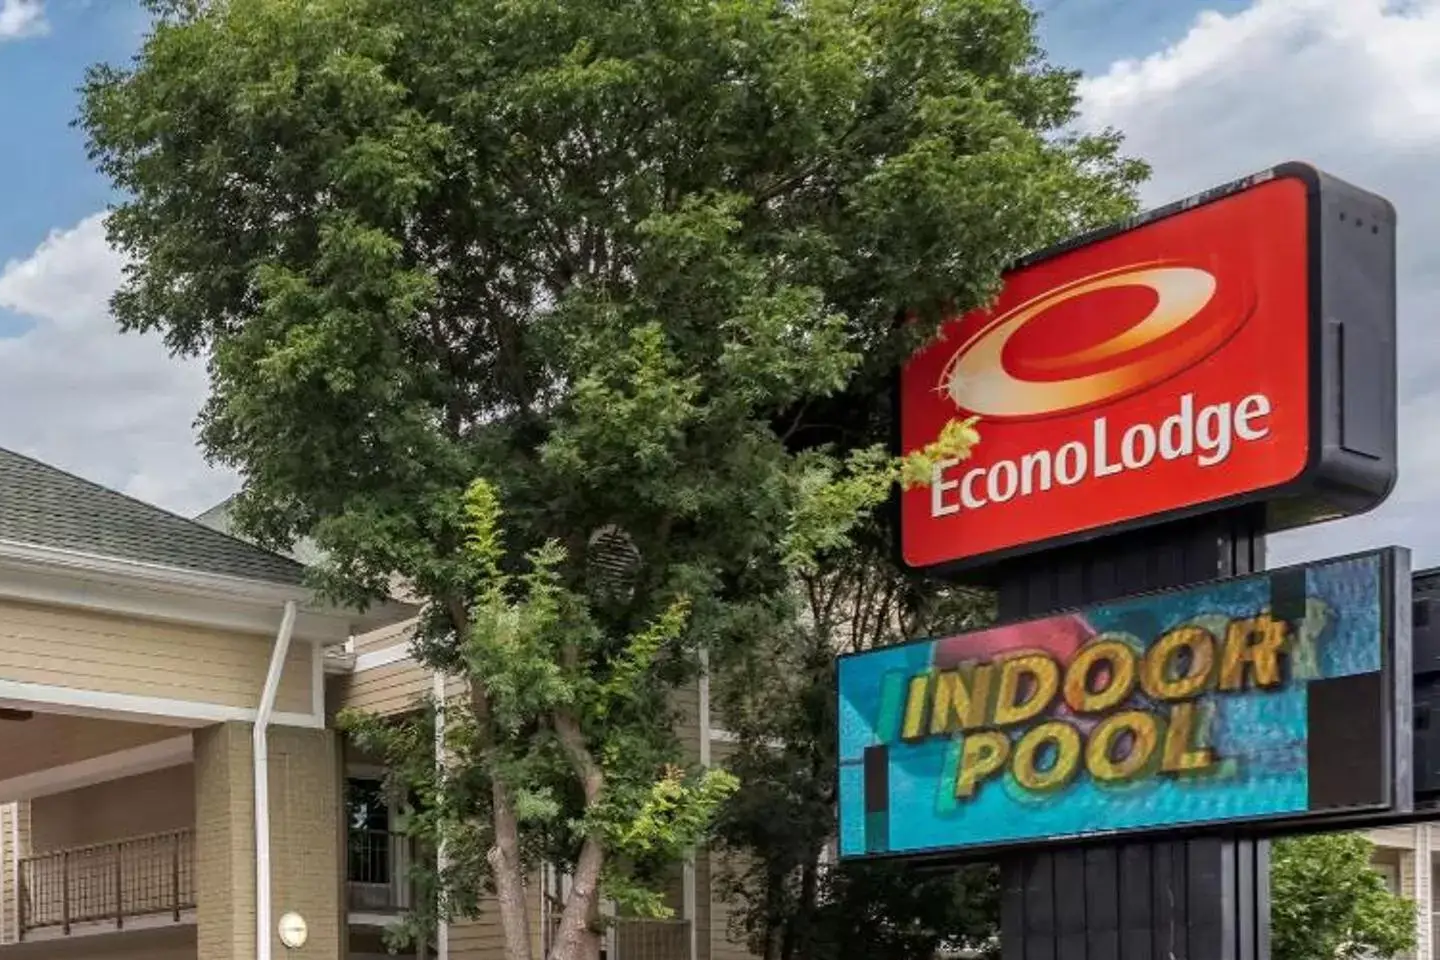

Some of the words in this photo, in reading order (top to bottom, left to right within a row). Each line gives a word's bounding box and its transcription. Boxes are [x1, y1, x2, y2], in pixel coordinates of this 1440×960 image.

[930, 392, 1272, 518] EconoLodge
[900, 612, 1289, 741] INDOOR
[953, 700, 1217, 799] POOL
